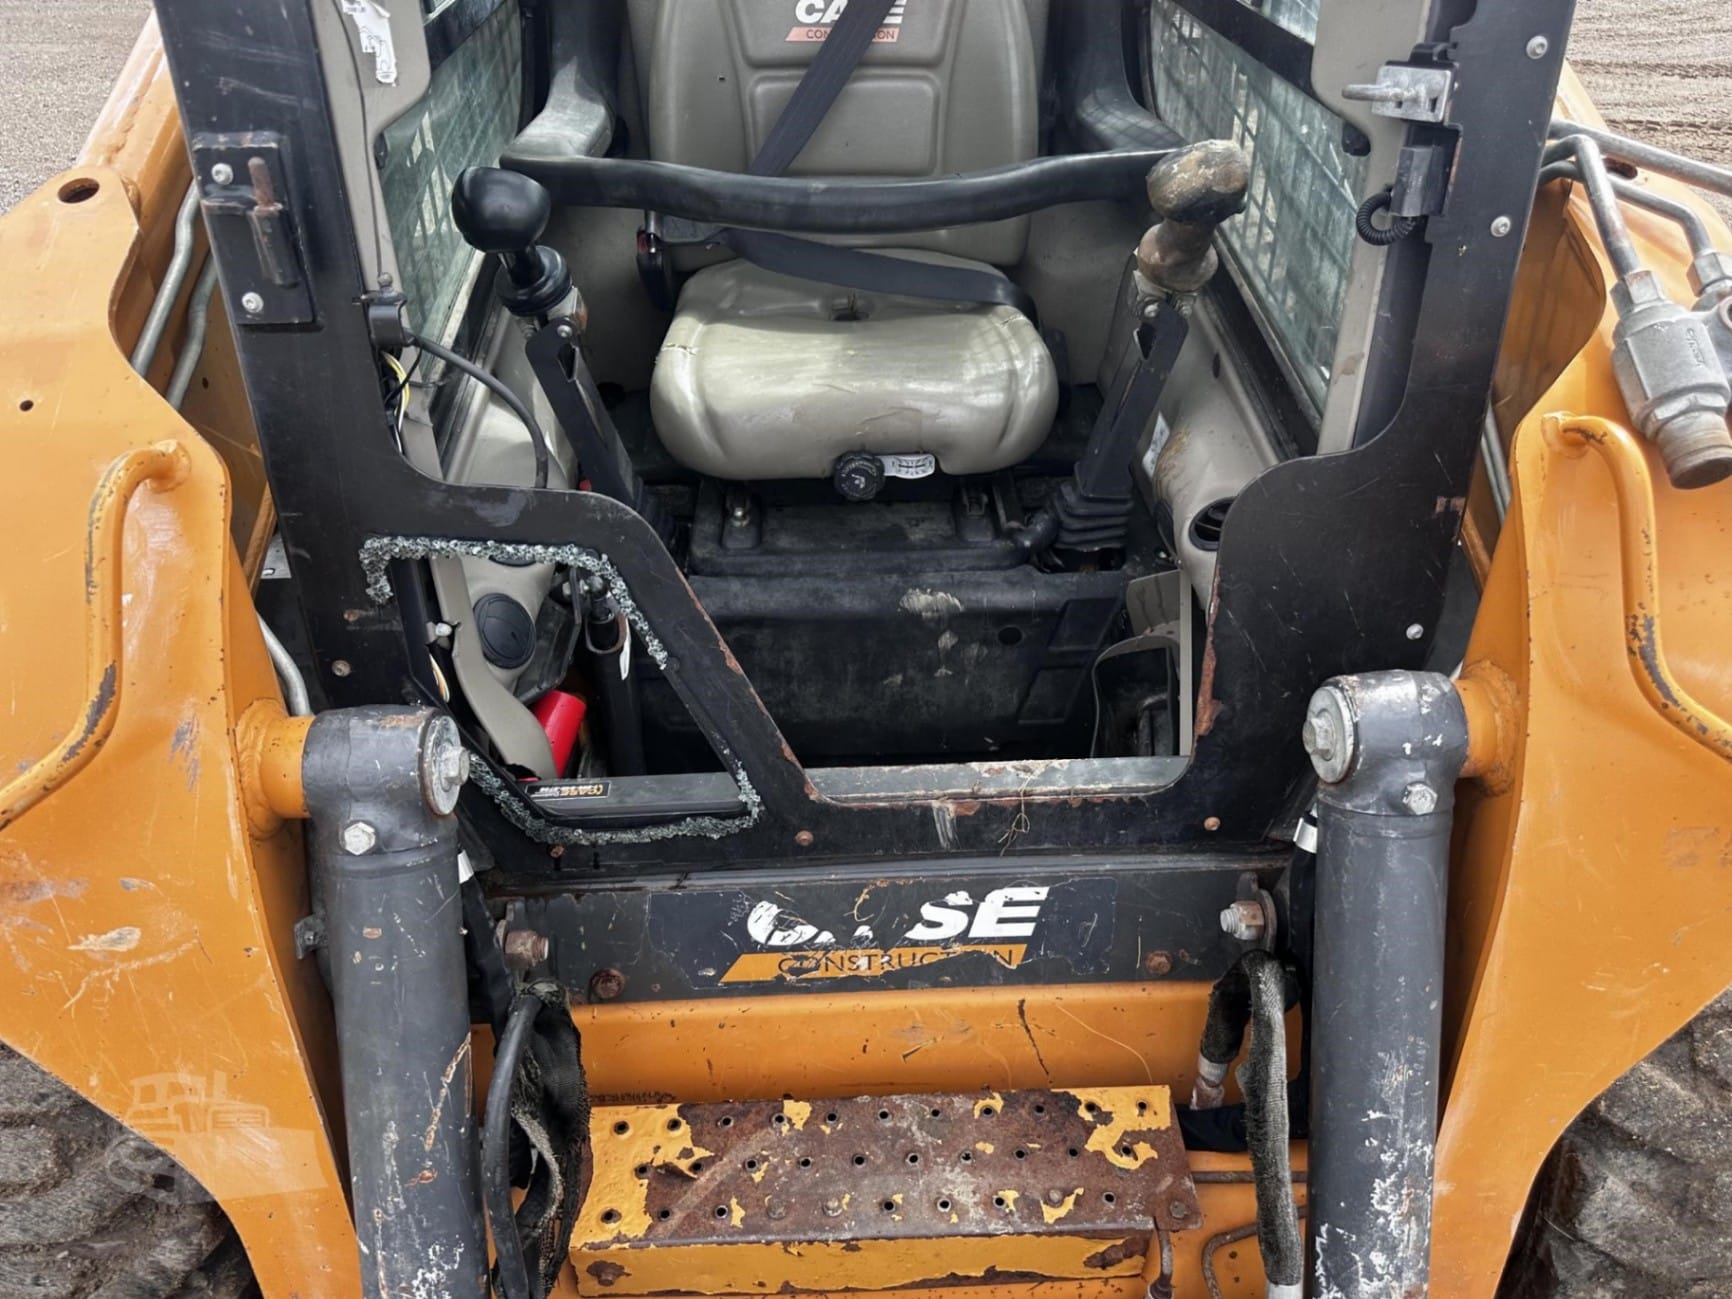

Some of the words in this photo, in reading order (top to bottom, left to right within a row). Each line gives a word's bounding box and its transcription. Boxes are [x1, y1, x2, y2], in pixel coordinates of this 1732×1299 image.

[795, 0, 907, 24] CAE
[747, 886, 1050, 946] CSE
[778, 948, 1013, 974] CNSTRUCN
